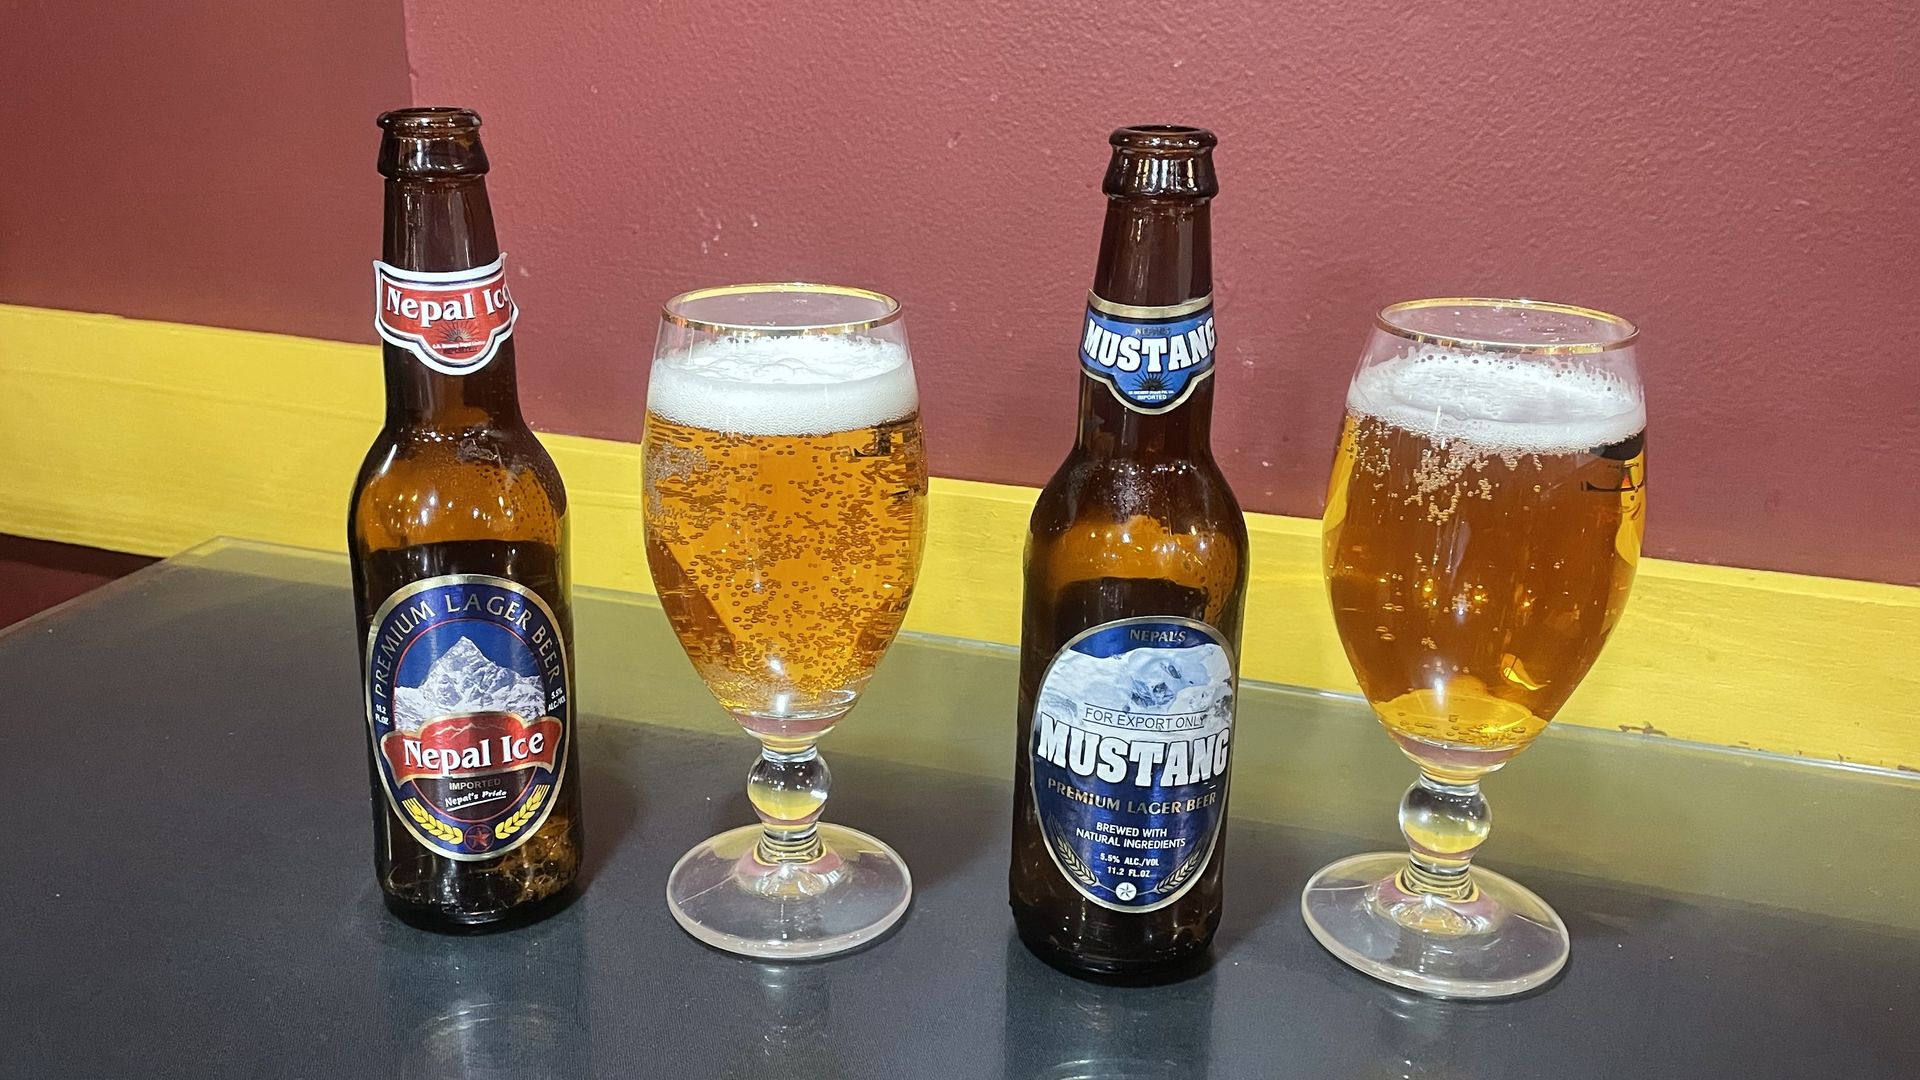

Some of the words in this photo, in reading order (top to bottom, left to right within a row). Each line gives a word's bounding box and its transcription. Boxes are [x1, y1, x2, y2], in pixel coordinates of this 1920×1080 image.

[387, 285, 476, 328] Nepal
[1084, 316, 1217, 373] MUSTANG
[374, 600, 436, 698] PREMIUM
[445, 593, 533, 631] LAGER
[531, 625, 562, 683] BEER
[1129, 628, 1187, 643] NEPAL'S
[1085, 707, 1113, 725] FOR
[1117, 713, 1173, 729] EXPORT
[1175, 713, 1205, 729] ONLY
[402, 738, 491, 777] Nepal
[500, 731, 544, 763] Ice
[1037, 711, 1230, 787] MUSTANG
[449, 779, 501, 790] IMPORTED
[444, 792, 479, 807] Nepal's
[482, 789, 507, 798] Pride
[1048, 777, 1120, 811] PREMIUM
[1127, 801, 1181, 815] LAGER
[1186, 791, 1216, 812] BEER
[1076, 827, 1121, 847] NATURAL
[1123, 838, 1186, 849] INGREDIENTS
[1096, 821, 1140, 837] BREWED
[1142, 828, 1168, 837] WITH
[1100, 853, 1120, 864] 5.5%
[1107, 866, 1125, 876] 11.2
